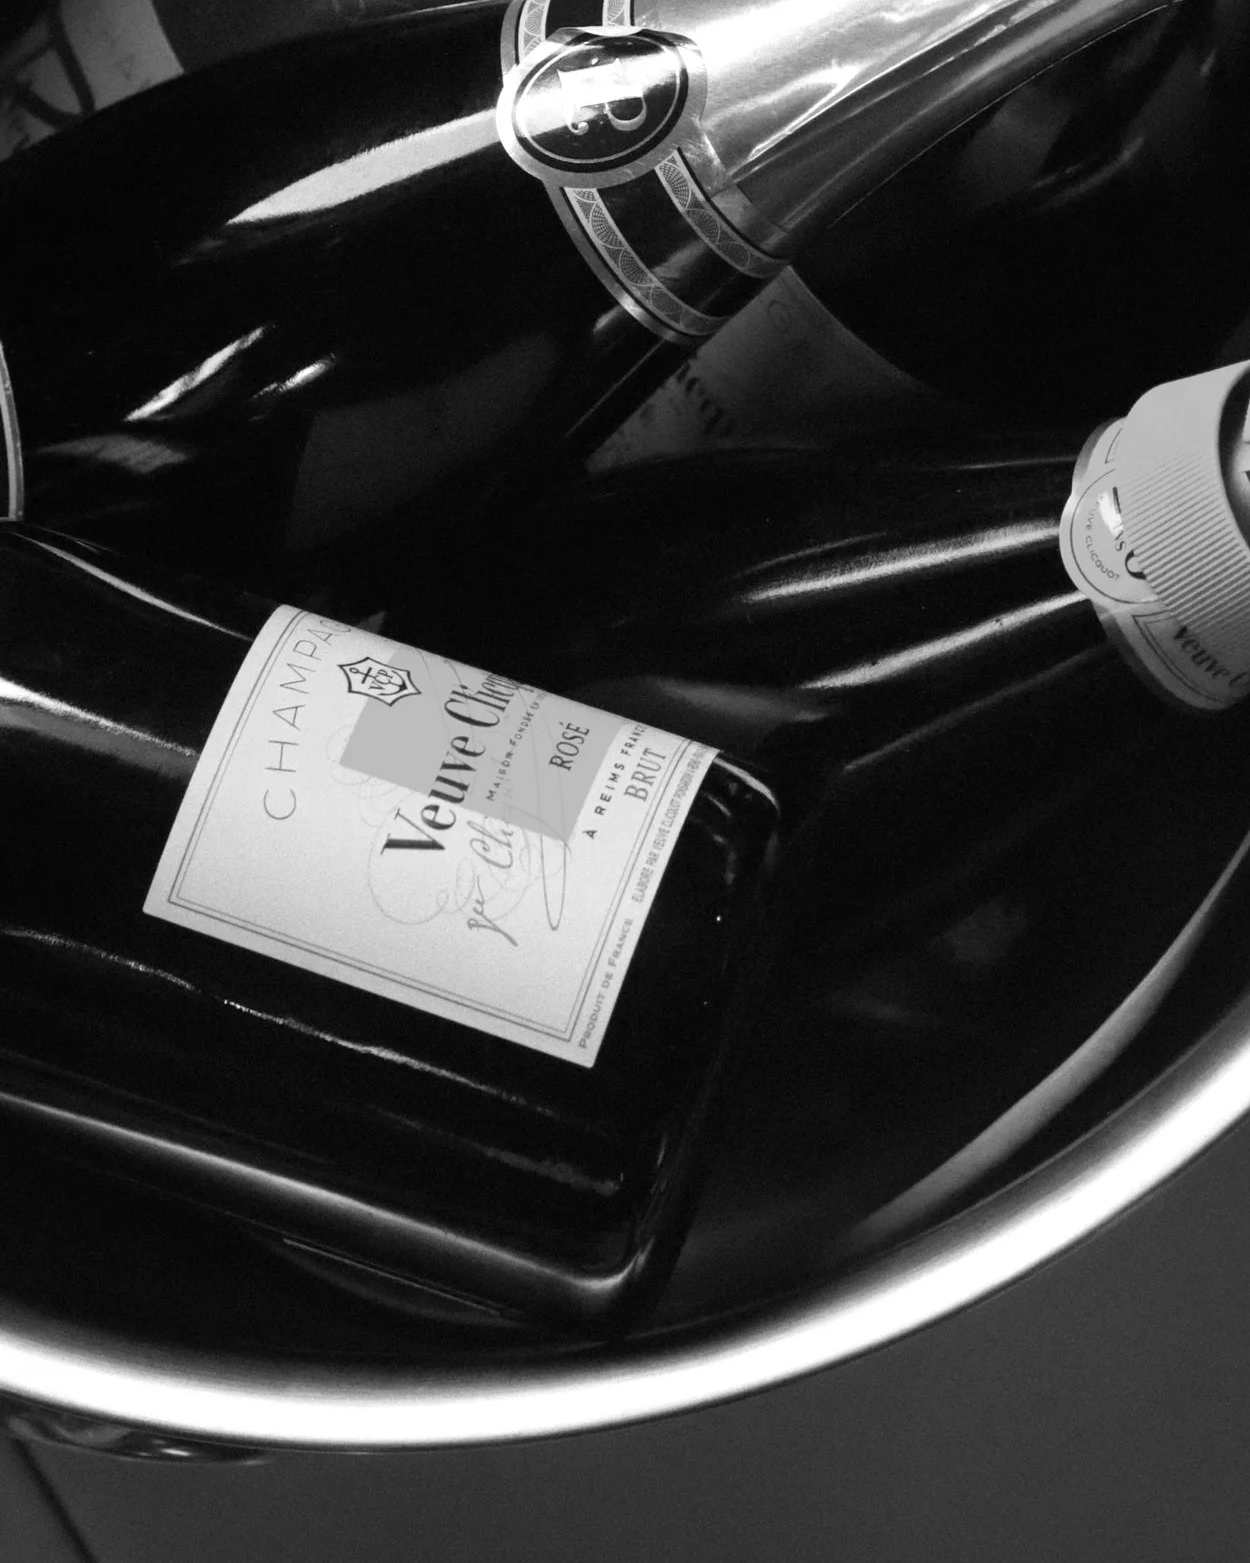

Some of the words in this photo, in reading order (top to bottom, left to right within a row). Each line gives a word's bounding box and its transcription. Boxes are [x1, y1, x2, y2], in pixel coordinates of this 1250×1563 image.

[548, 721, 591, 771] ROSÉ
[381, 736, 486, 855] Veuve
[485, 751, 514, 801] MAISON
[594, 762, 625, 816] REIMS
[624, 747, 667, 802] BRUT
[578, 993, 606, 1050] PRODUIT
[601, 971, 613, 989] DE
[608, 918, 634, 968] FRANCE
